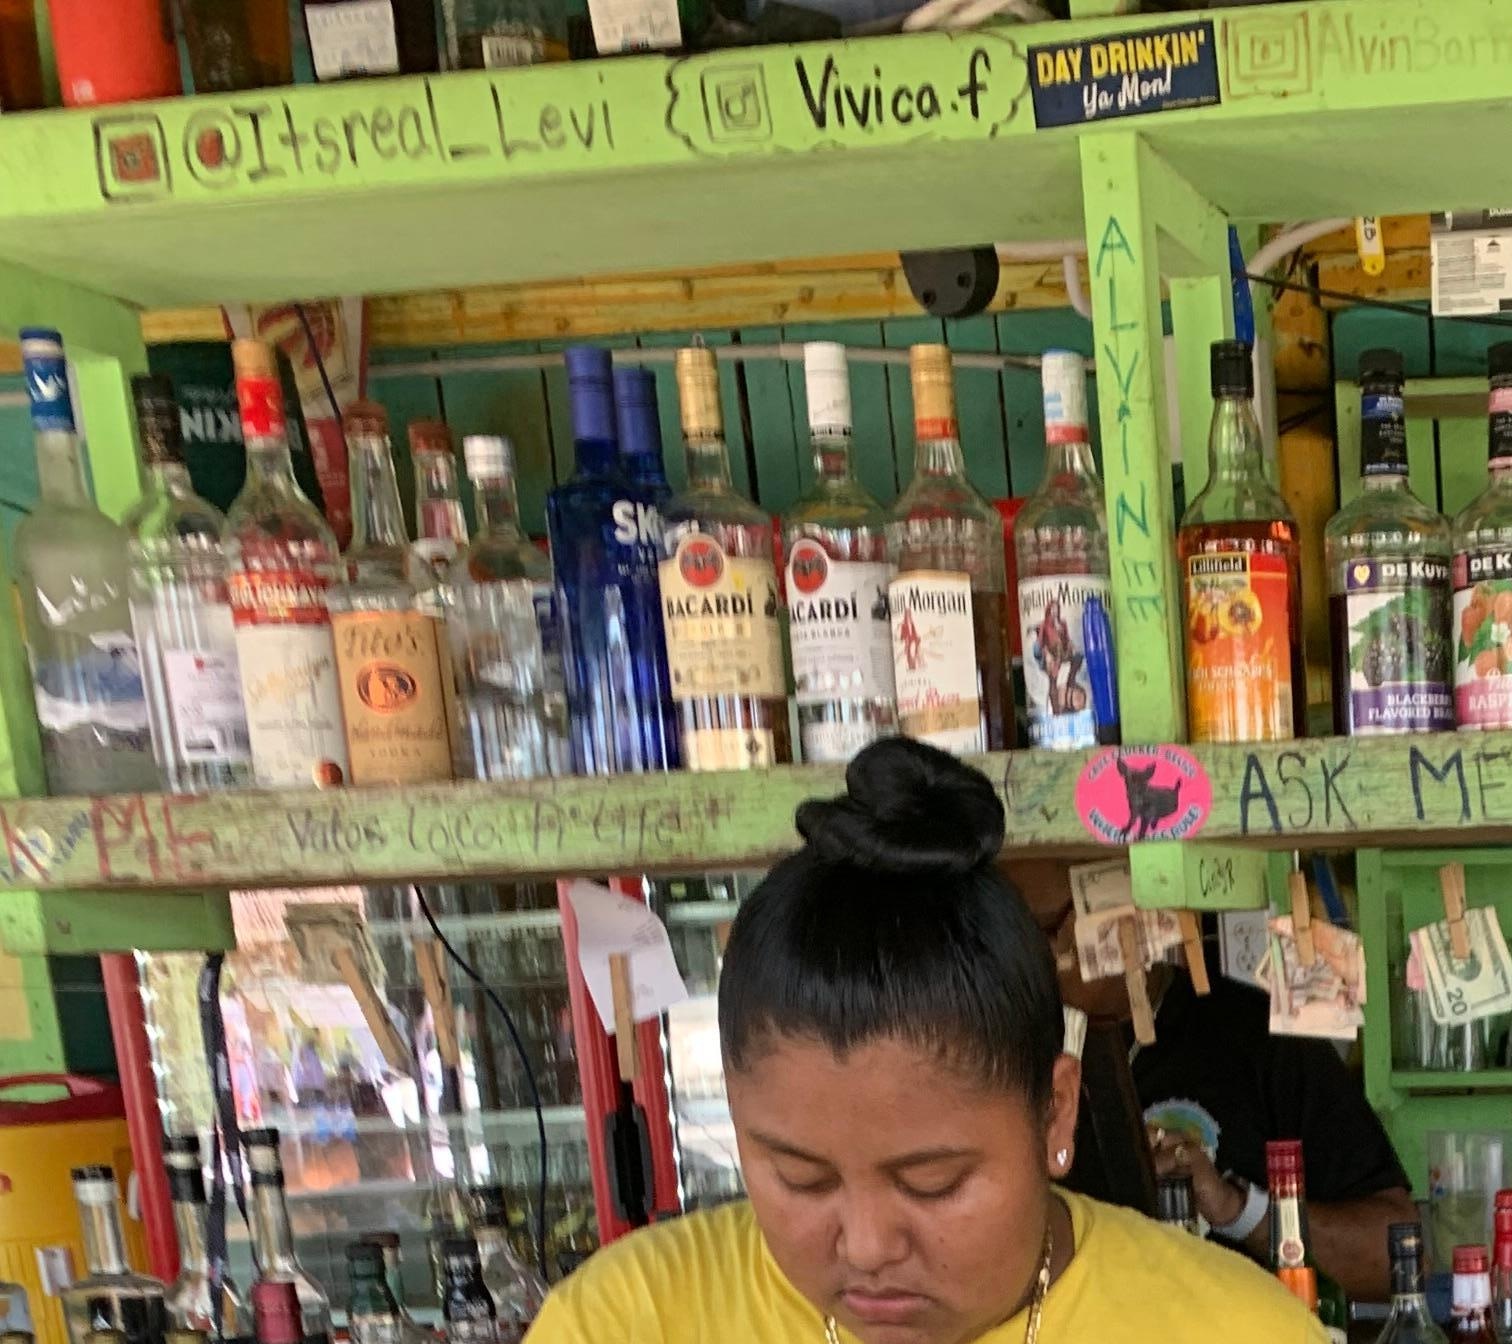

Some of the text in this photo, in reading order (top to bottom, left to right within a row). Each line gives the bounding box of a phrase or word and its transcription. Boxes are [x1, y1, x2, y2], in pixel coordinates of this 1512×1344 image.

[1036, 29, 1206, 88] DAY DRINKIN'
[1083, 84, 1114, 119] Ya
[1382, 562, 1408, 577] DE
[1470, 555, 1494, 572] DE
[909, 584, 968, 618] Morgan
[1240, 752, 1358, 836] ASK
[1446, 985, 1468, 1017] 20
